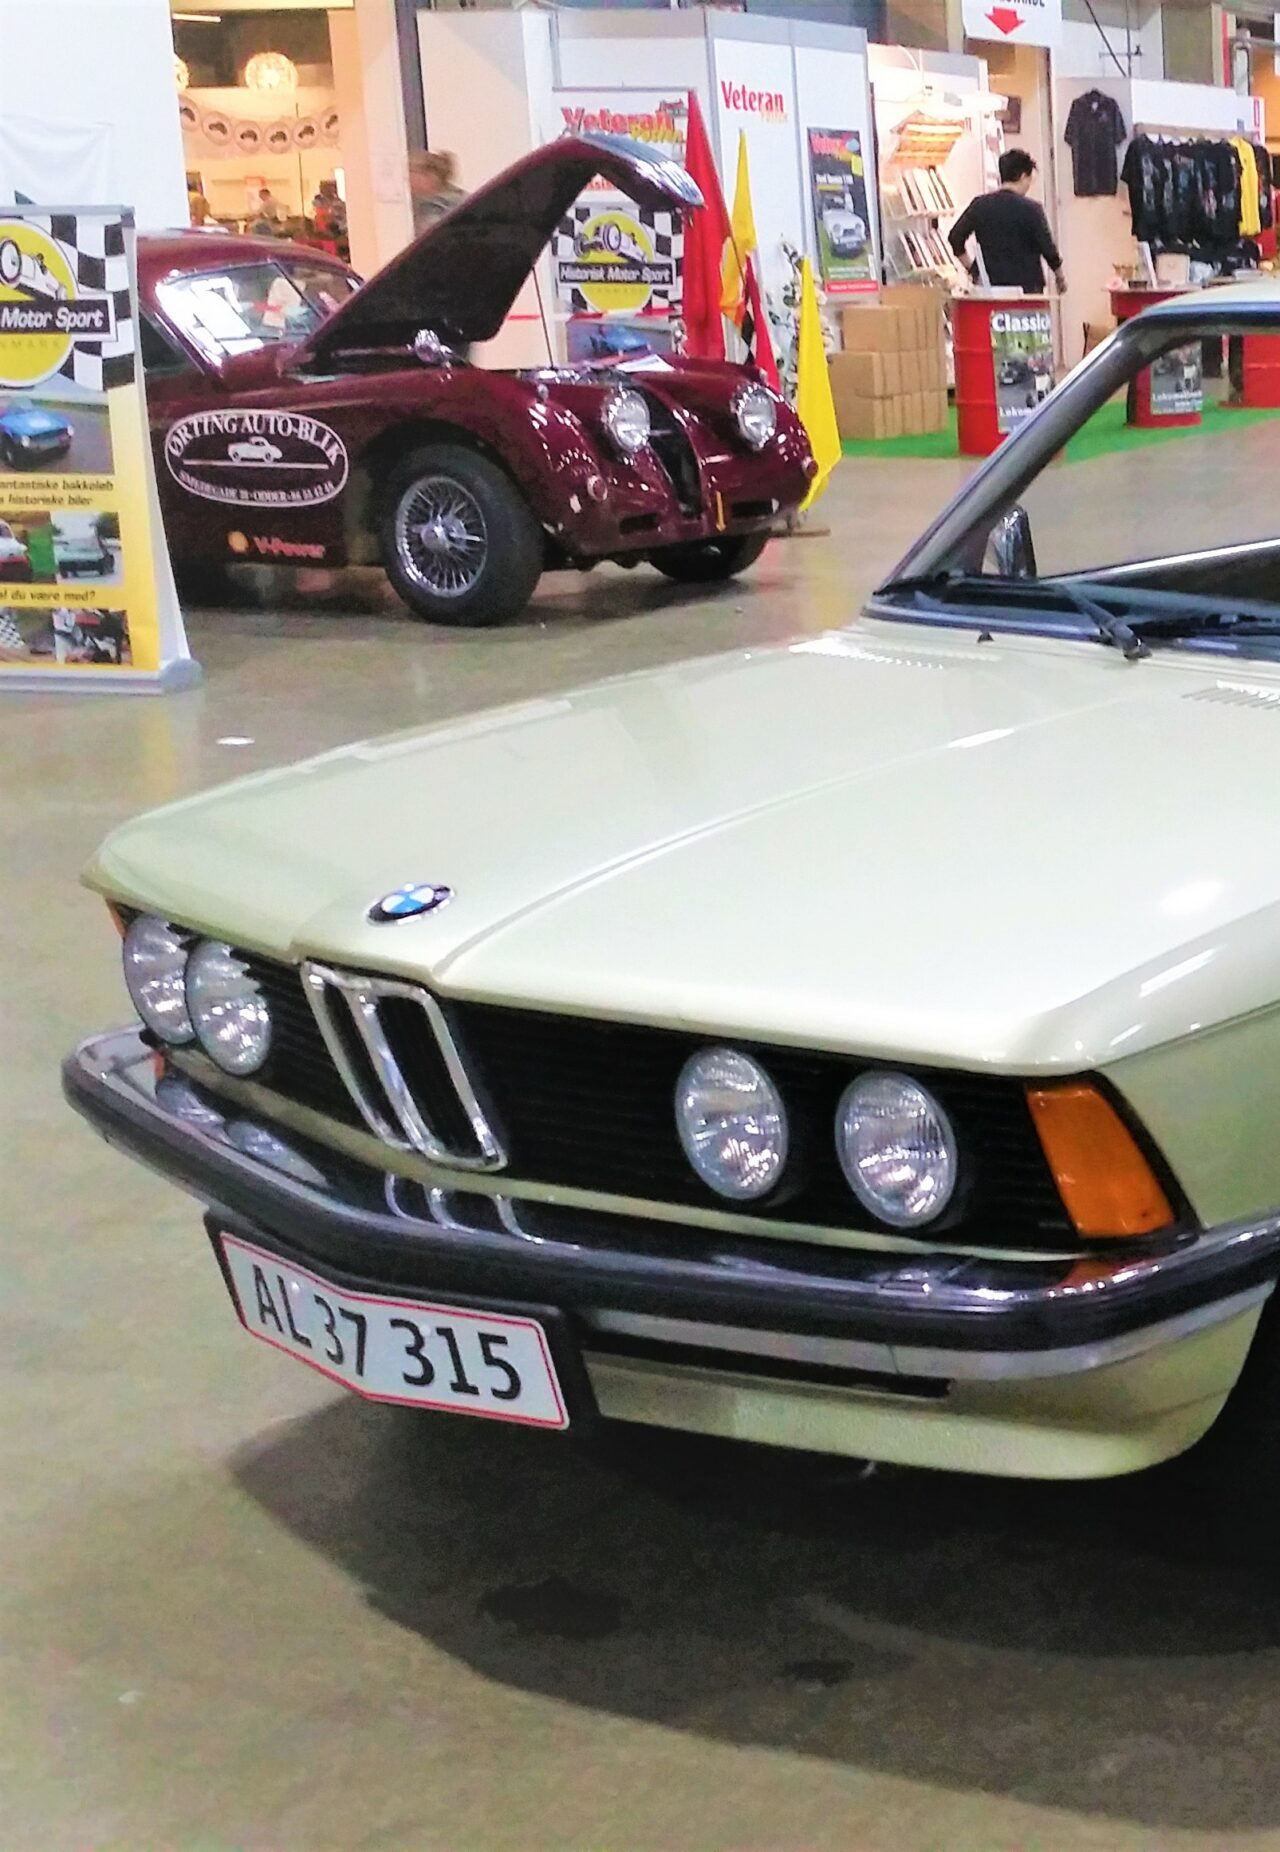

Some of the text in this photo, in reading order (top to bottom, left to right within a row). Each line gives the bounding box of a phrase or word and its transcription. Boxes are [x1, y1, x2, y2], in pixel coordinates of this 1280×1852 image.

[721, 80, 784, 113] Veteran
[561, 104, 675, 134] Veteran
[606, 265, 640, 281] Motor
[641, 266, 671, 285] Sport
[0, 306, 105, 333] Motor Sport
[168, 414, 238, 458] ØRTING
[389, 1318, 522, 1400] 315
